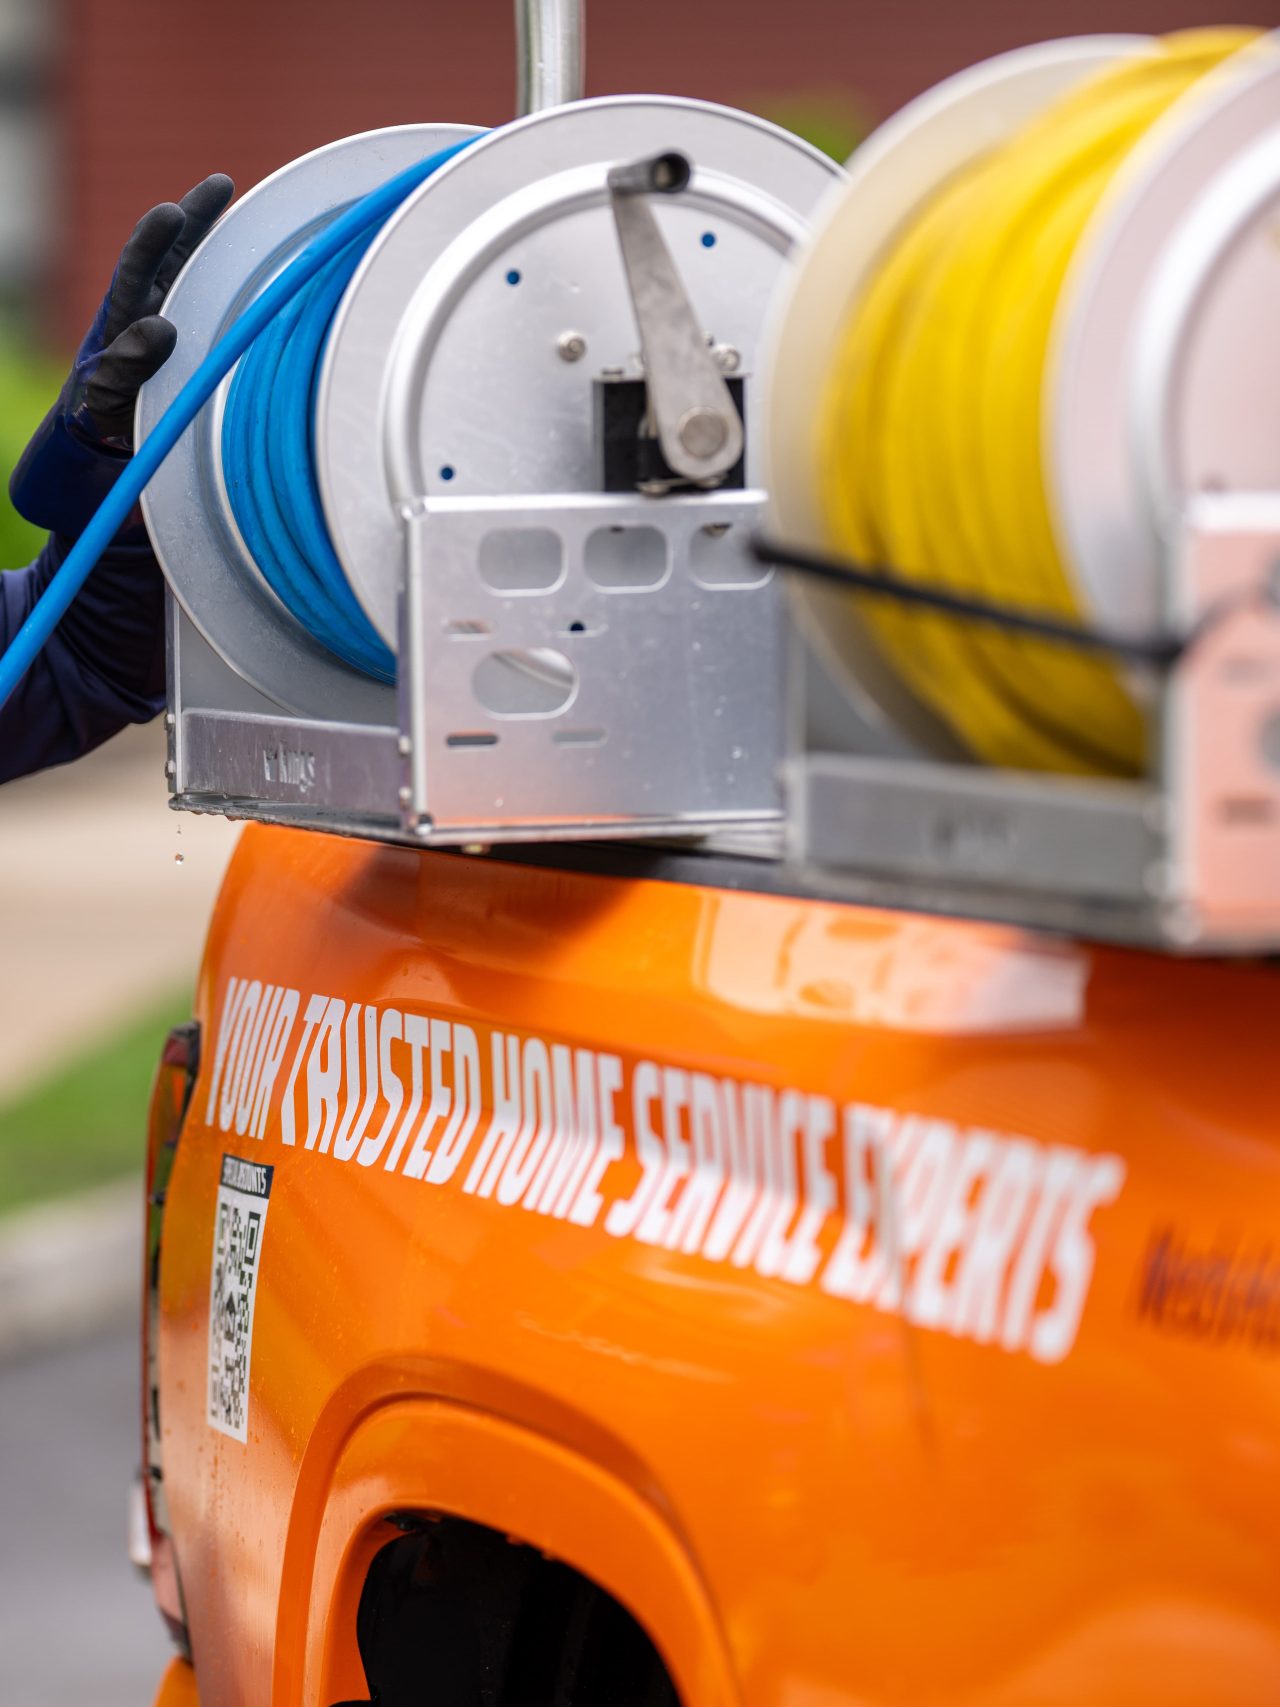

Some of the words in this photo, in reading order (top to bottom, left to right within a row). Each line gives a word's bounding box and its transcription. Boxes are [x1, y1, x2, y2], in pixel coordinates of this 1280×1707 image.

[205, 976, 300, 1140] YOUR
[281, 994, 481, 1185] TRUSTED
[462, 1032, 624, 1228] HOME
[605, 1061, 837, 1284] SERVICE
[823, 1102, 1125, 1364] EXPERTS
